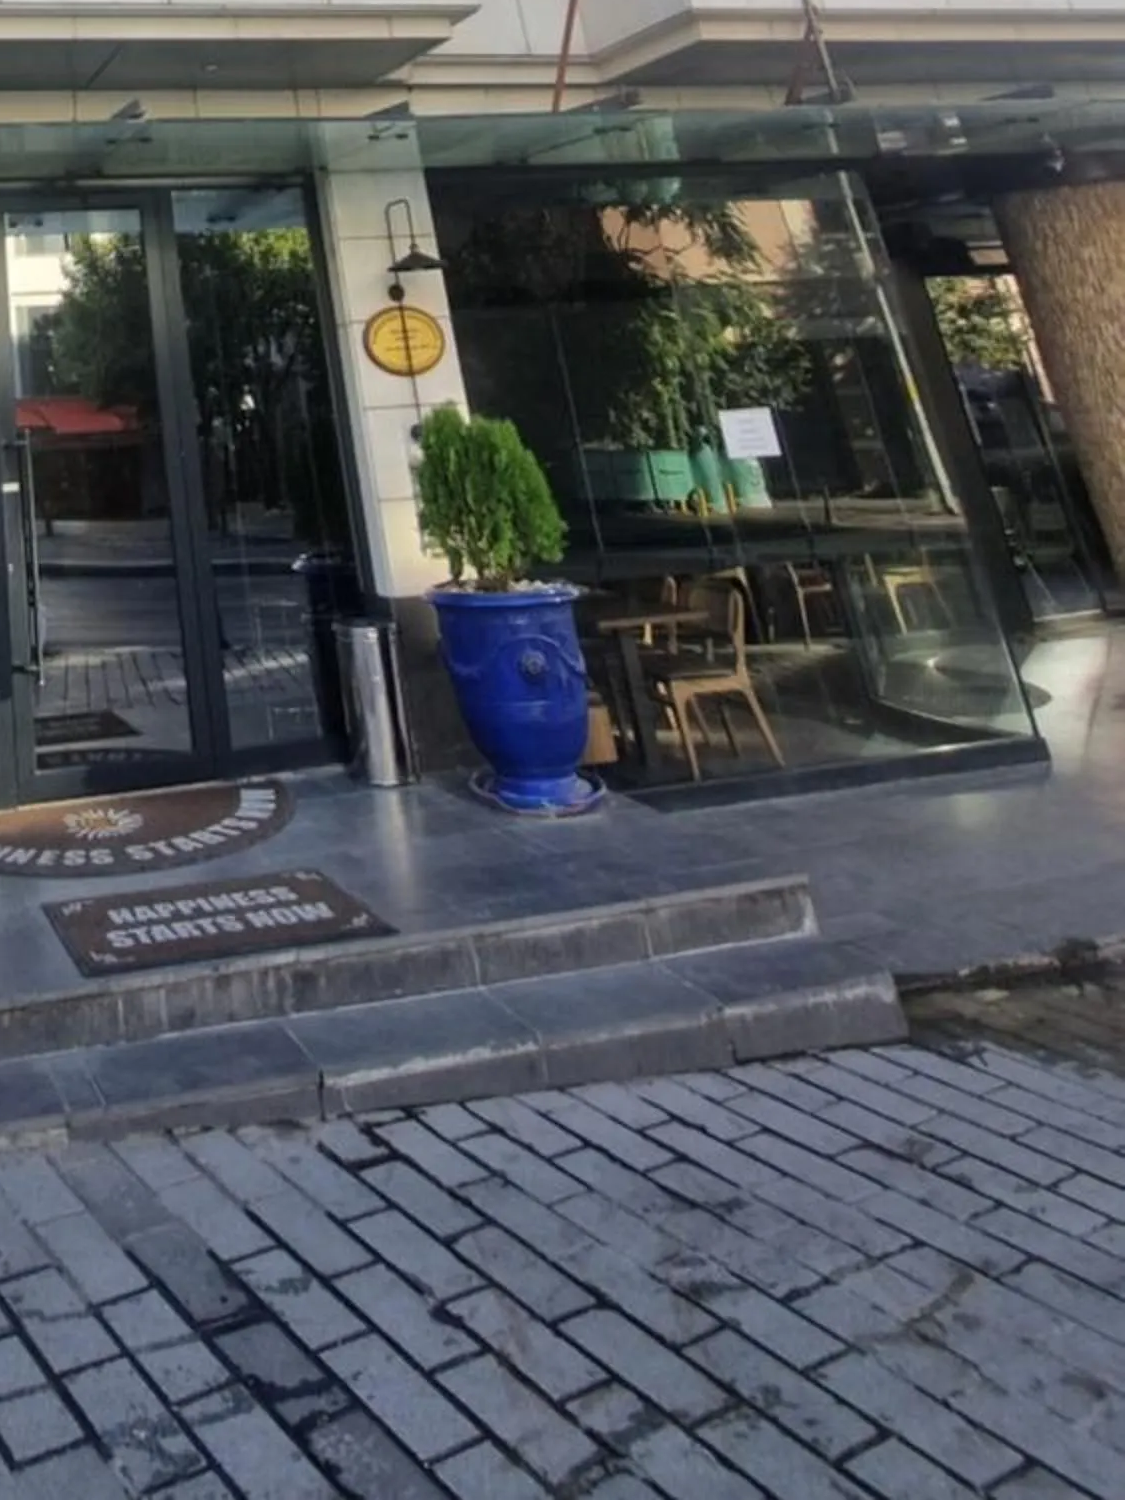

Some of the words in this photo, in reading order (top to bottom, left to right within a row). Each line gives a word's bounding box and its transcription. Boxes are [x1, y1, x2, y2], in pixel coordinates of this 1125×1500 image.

[125, 817, 259, 862] STARTS
[106, 886, 300, 926] HAPPINESS
[106, 914, 245, 948] STARTS
[246, 901, 336, 930] NOW
